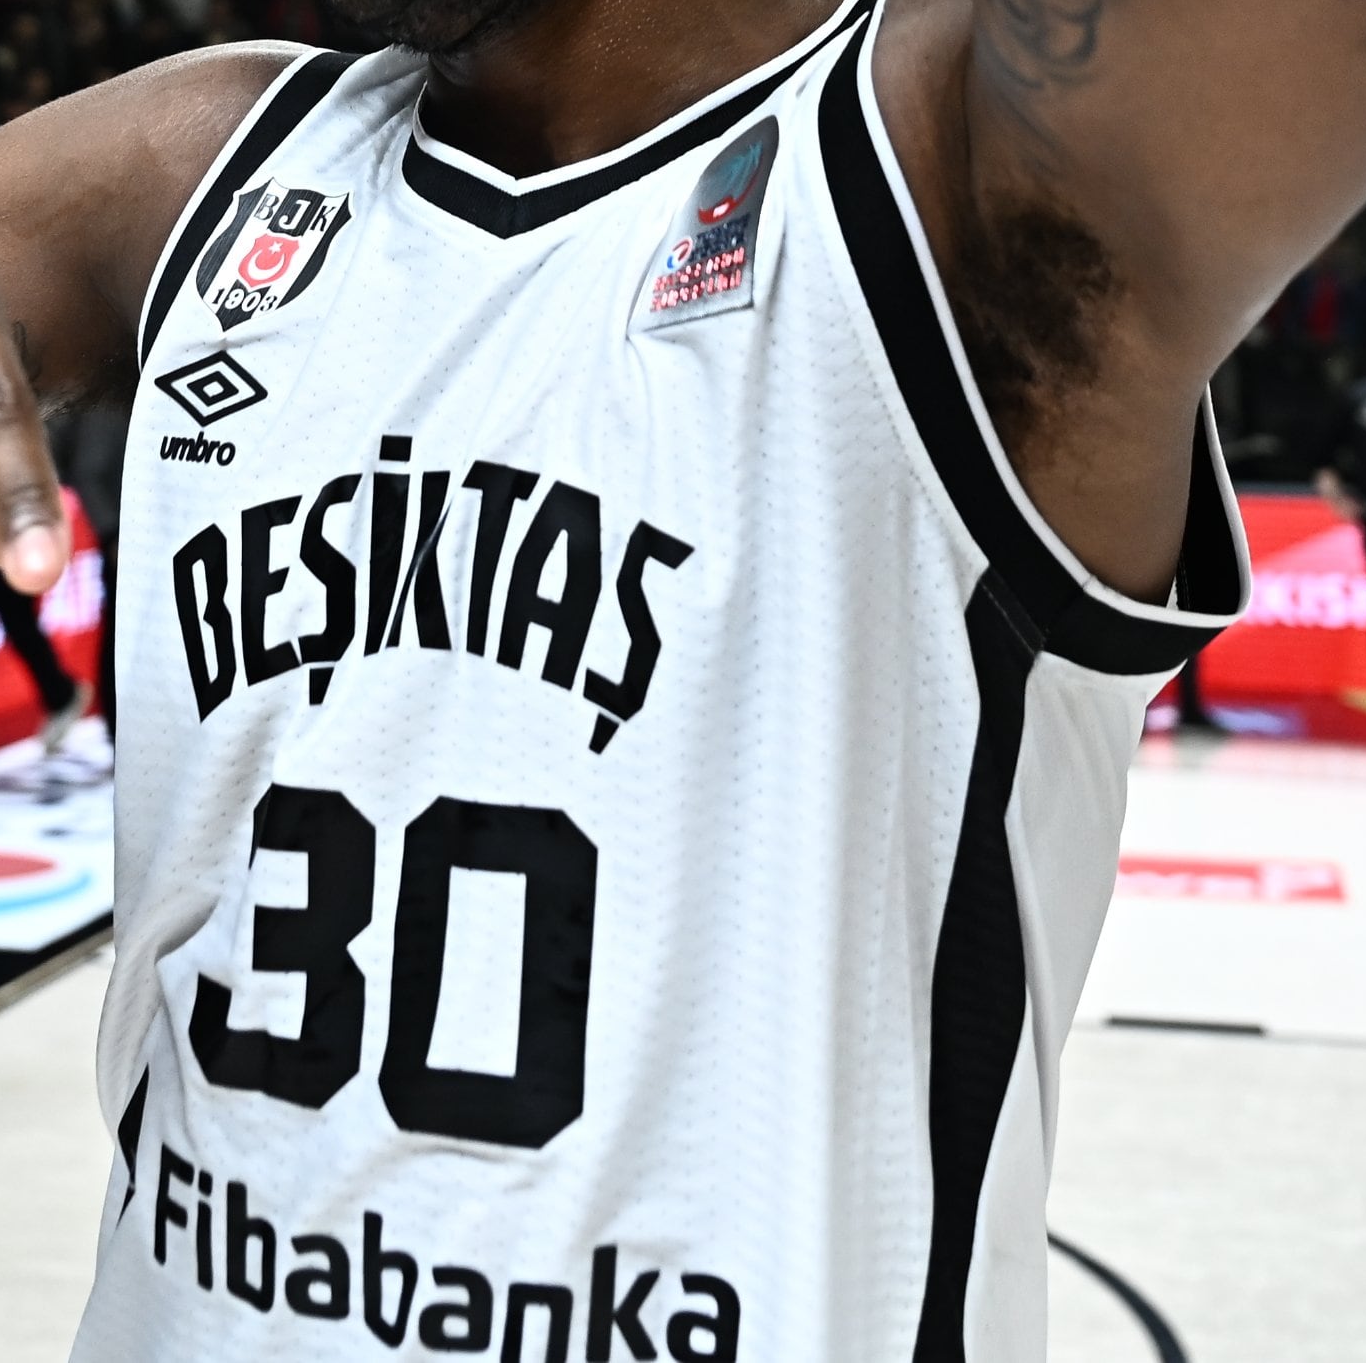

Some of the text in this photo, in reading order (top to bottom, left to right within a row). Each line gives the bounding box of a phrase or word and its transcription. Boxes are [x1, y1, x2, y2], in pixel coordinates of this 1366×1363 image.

[253, 193, 337, 232] BJK
[211, 288, 279, 313] 1903
[160, 433, 236, 467] umbro
[172, 434, 695, 755] BEŞİKTAŞ
[188, 782, 599, 1151] 30
[153, 1141, 742, 1363] Fibabanka
